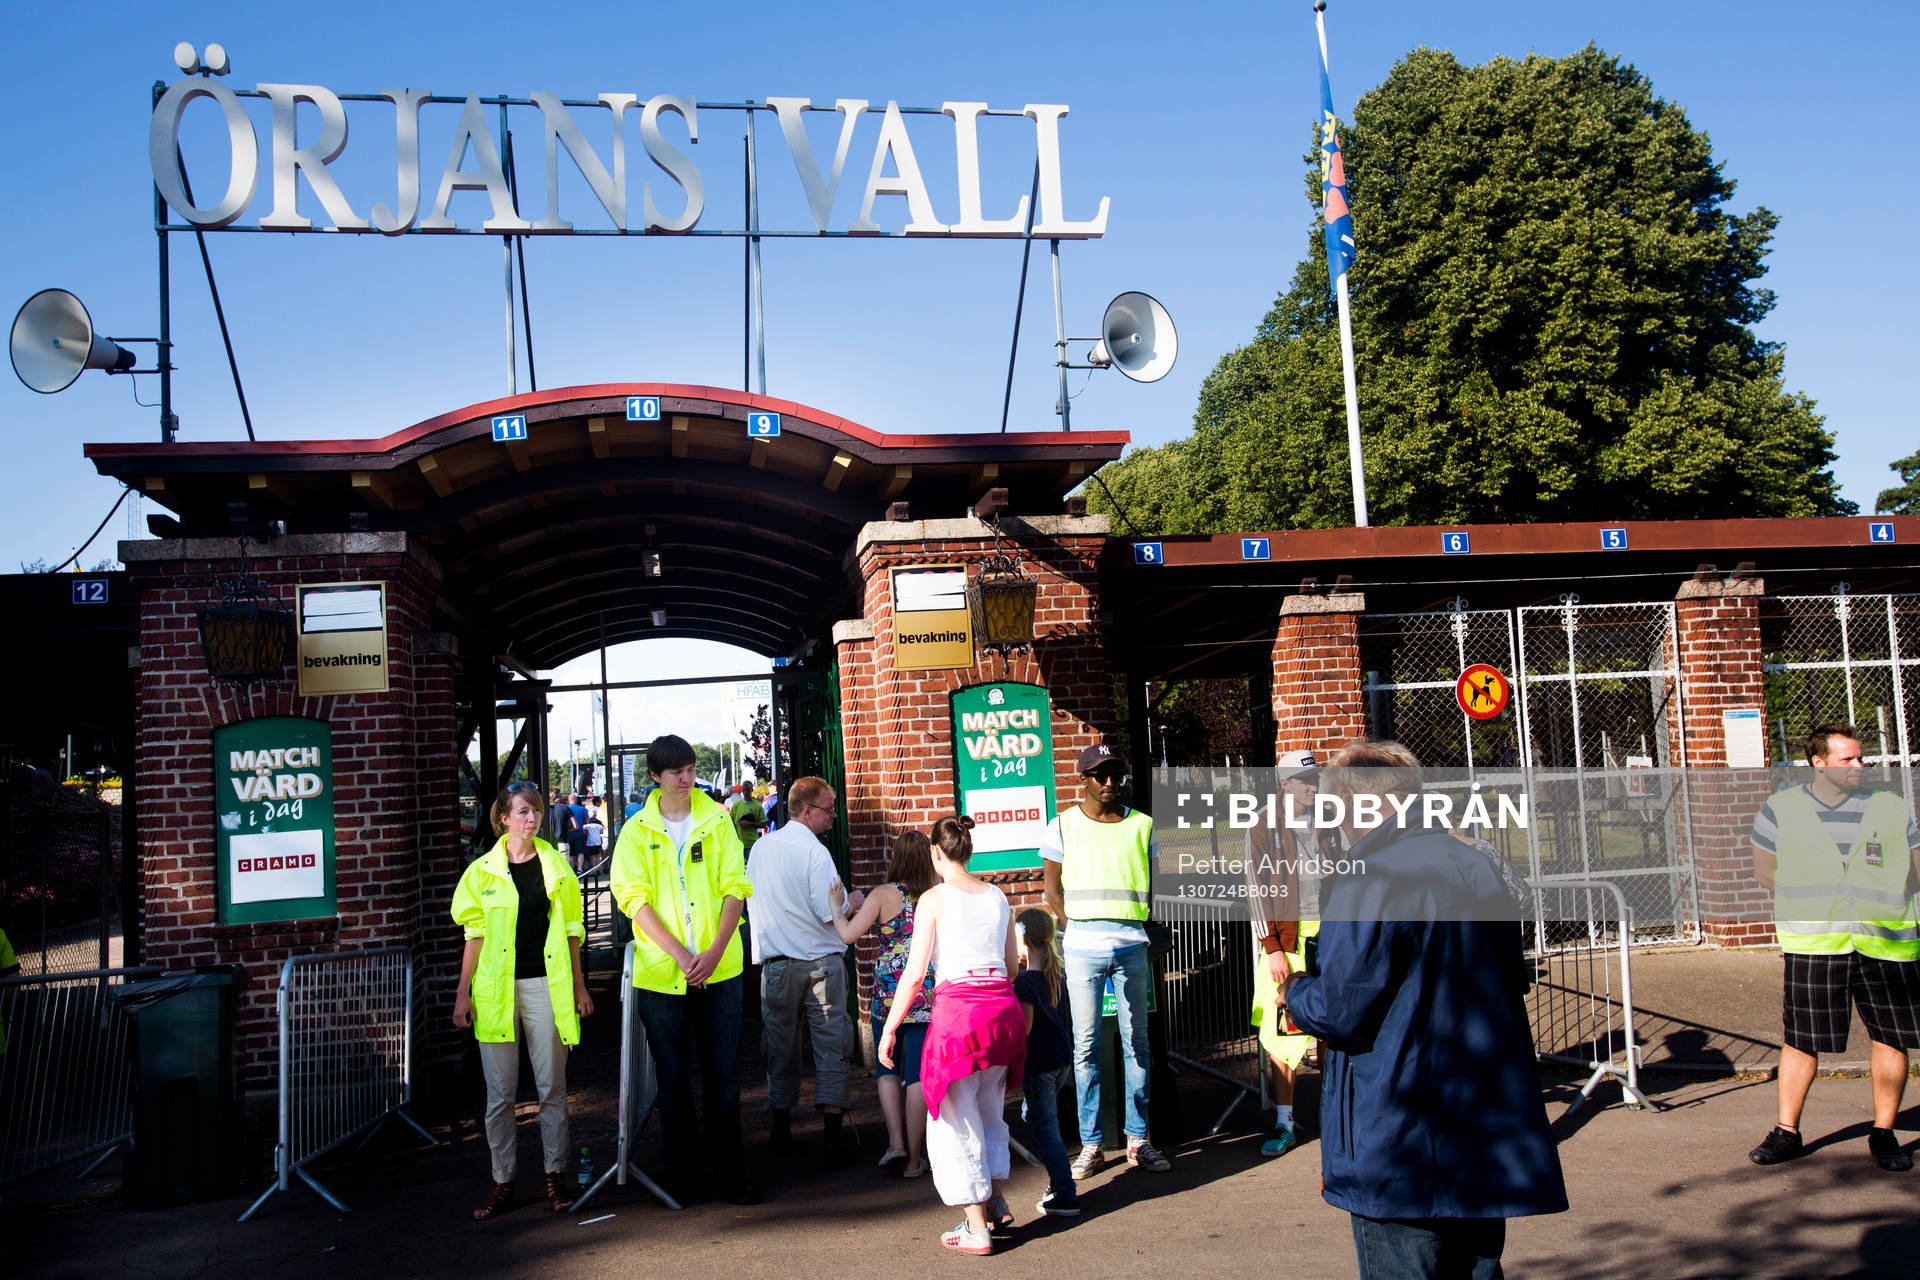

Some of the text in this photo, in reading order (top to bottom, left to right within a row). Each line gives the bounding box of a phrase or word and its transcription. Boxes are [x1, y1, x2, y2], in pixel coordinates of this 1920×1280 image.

[149, 42, 1111, 239] ÖRJANS VALL
[629, 399, 656, 419] 10
[496, 418, 523, 439] 11
[758, 415, 771, 434] 9
[1608, 531, 1620, 547] 5
[1877, 525, 1888, 541] 4
[1250, 541, 1261, 557] 7
[1450, 535, 1462, 551] 6
[1142, 545, 1155, 562] 8
[75, 582, 104, 602] 12
[899, 631, 967, 645] bevakning
[304, 653, 381, 668] bevakning
[962, 709, 1040, 732] MATCH
[963, 729, 1042, 761] VÄRD
[230, 746, 320, 771] MATCH
[980, 757, 1027, 783] i dag
[231, 768, 323, 802] VÄRD
[249, 798, 303, 827] i dag
[975, 809, 1038, 823] CRAMO
[239, 855, 314, 871] CRAMO
